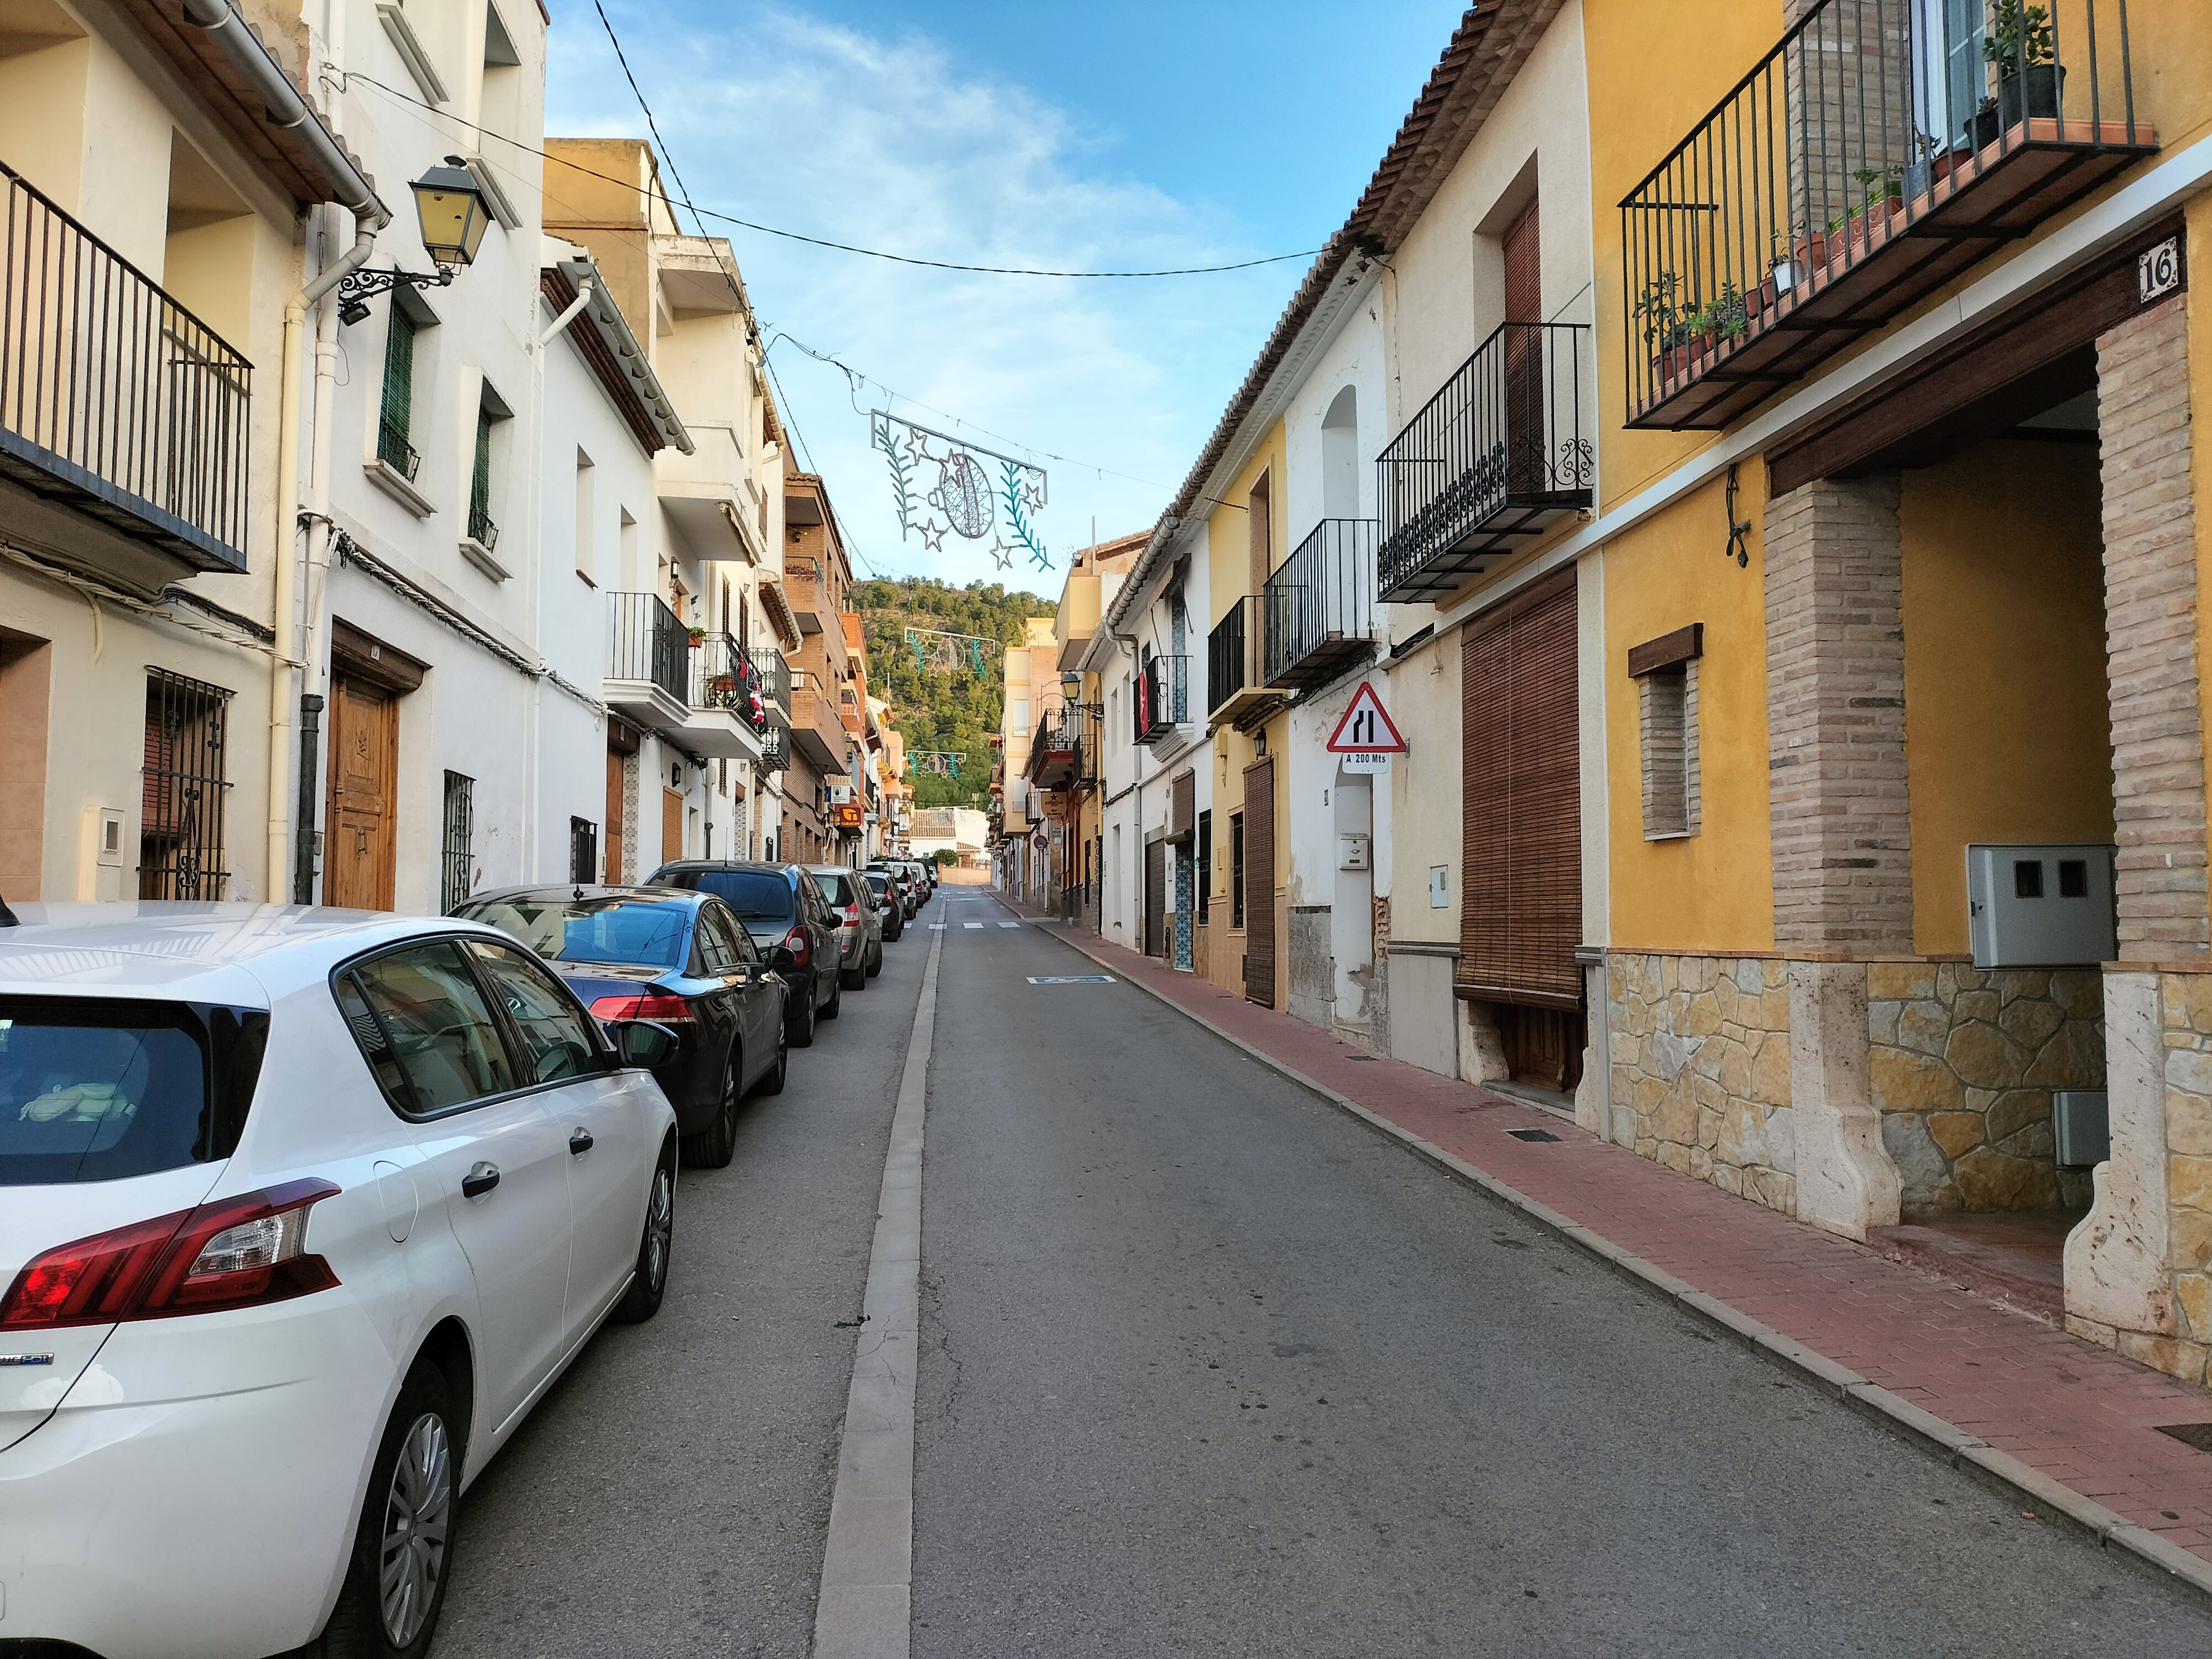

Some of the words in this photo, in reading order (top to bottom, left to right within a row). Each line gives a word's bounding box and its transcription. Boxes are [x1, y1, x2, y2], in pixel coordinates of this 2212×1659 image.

[2143, 248, 2172, 294] 16
[1346, 754, 1352, 763] A
[1355, 754, 1369, 763] 200
[1372, 754, 1386, 763] Mts
